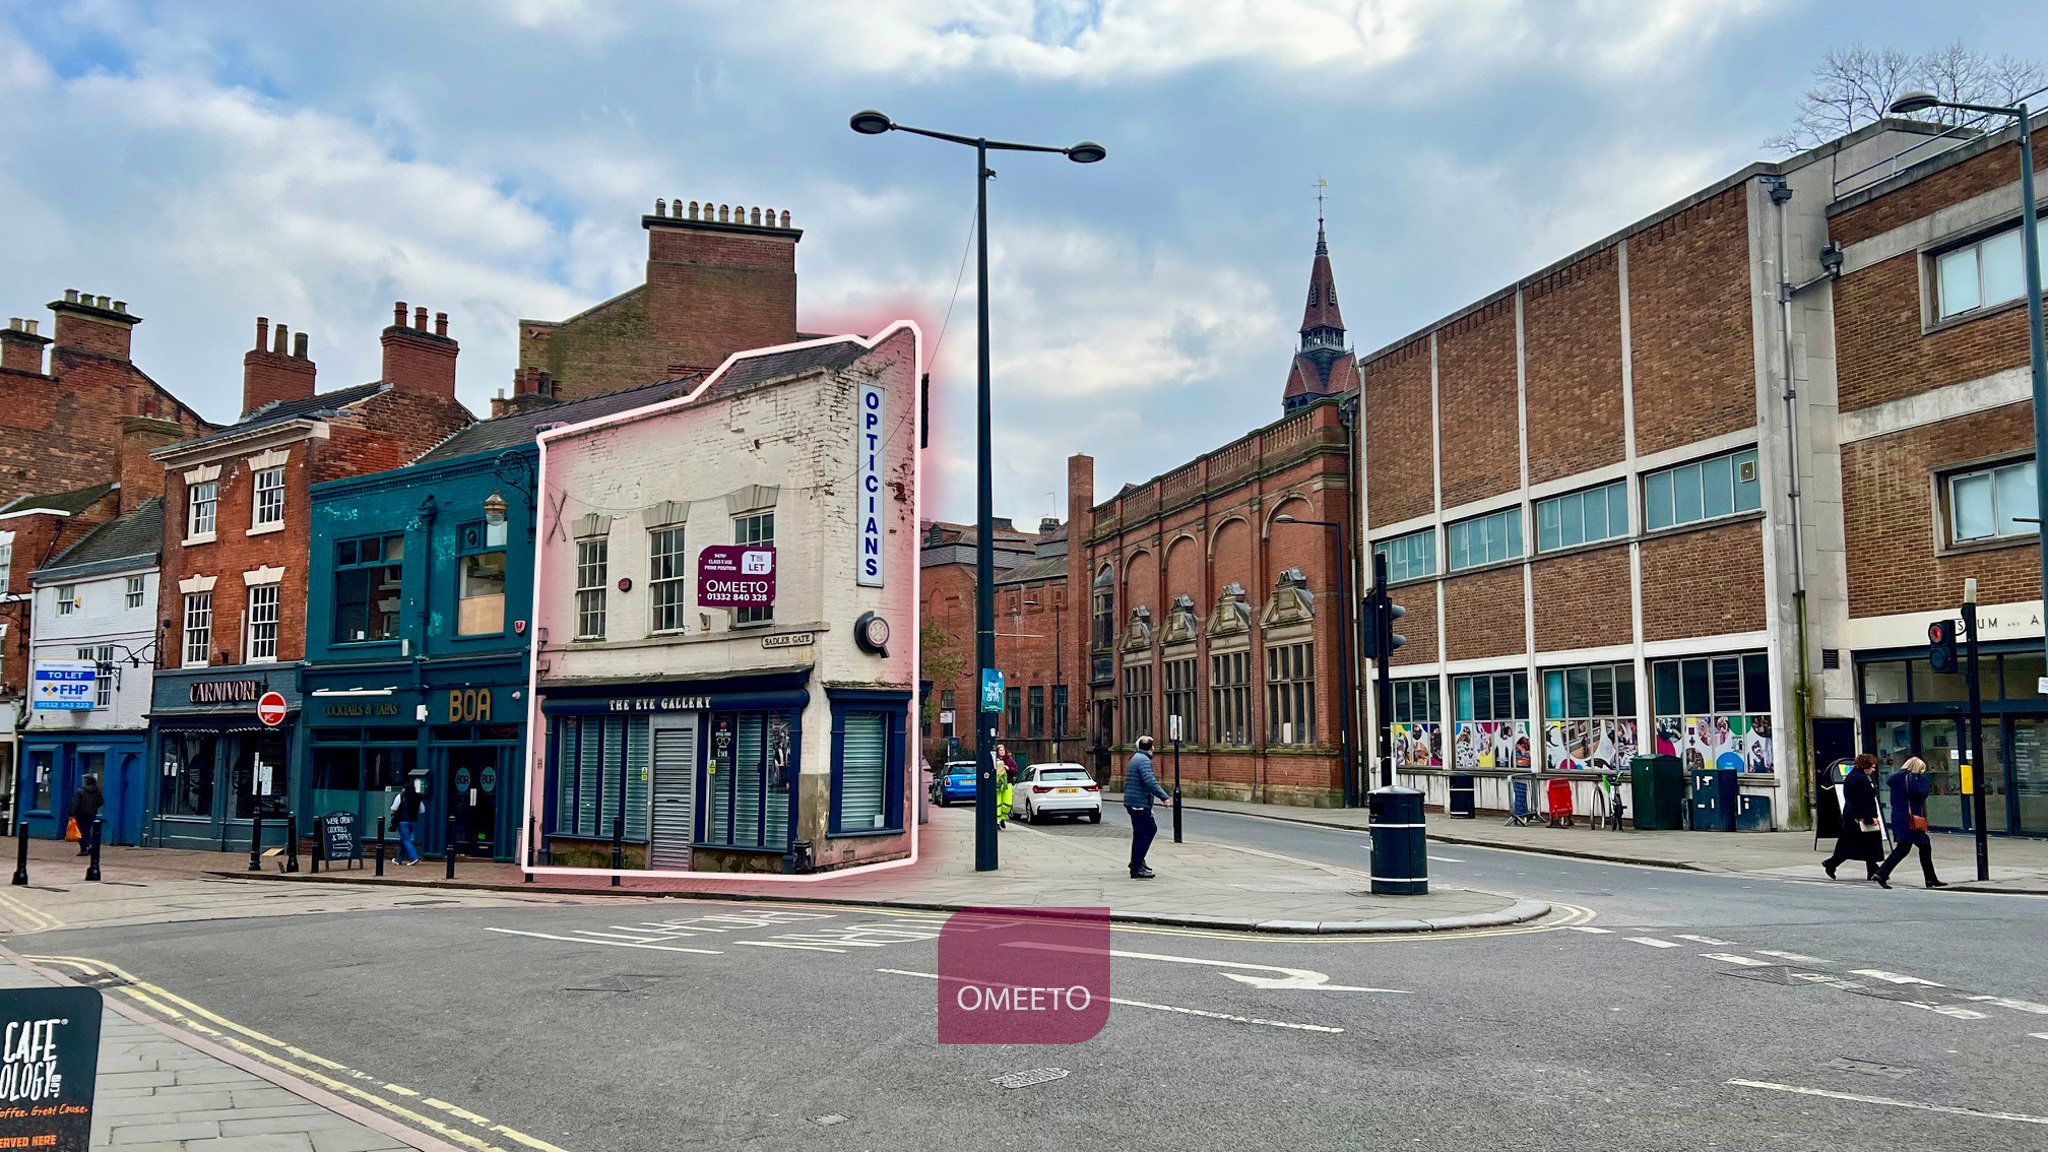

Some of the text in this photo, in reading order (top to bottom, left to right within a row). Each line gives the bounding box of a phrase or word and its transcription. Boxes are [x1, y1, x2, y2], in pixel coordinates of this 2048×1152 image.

[865, 391, 879, 576] OPTICIANS
[749, 563, 765, 571] LET
[706, 579, 768, 593] OMEETO
[707, 592, 767, 602] 01332 840 328
[764, 634, 810, 646] SADLER GATE
[48, 671, 83, 680] TO LET
[60, 684, 89, 696] FHP
[189, 680, 258, 702] CARNIVORE
[449, 688, 491, 722] BOA
[609, 696, 712, 711] THE EYE GALLERY
[31, 1104, 57, 1117] Great
[59, 1103, 88, 1115] Cause.
[31, 1134, 57, 1146] HERE
